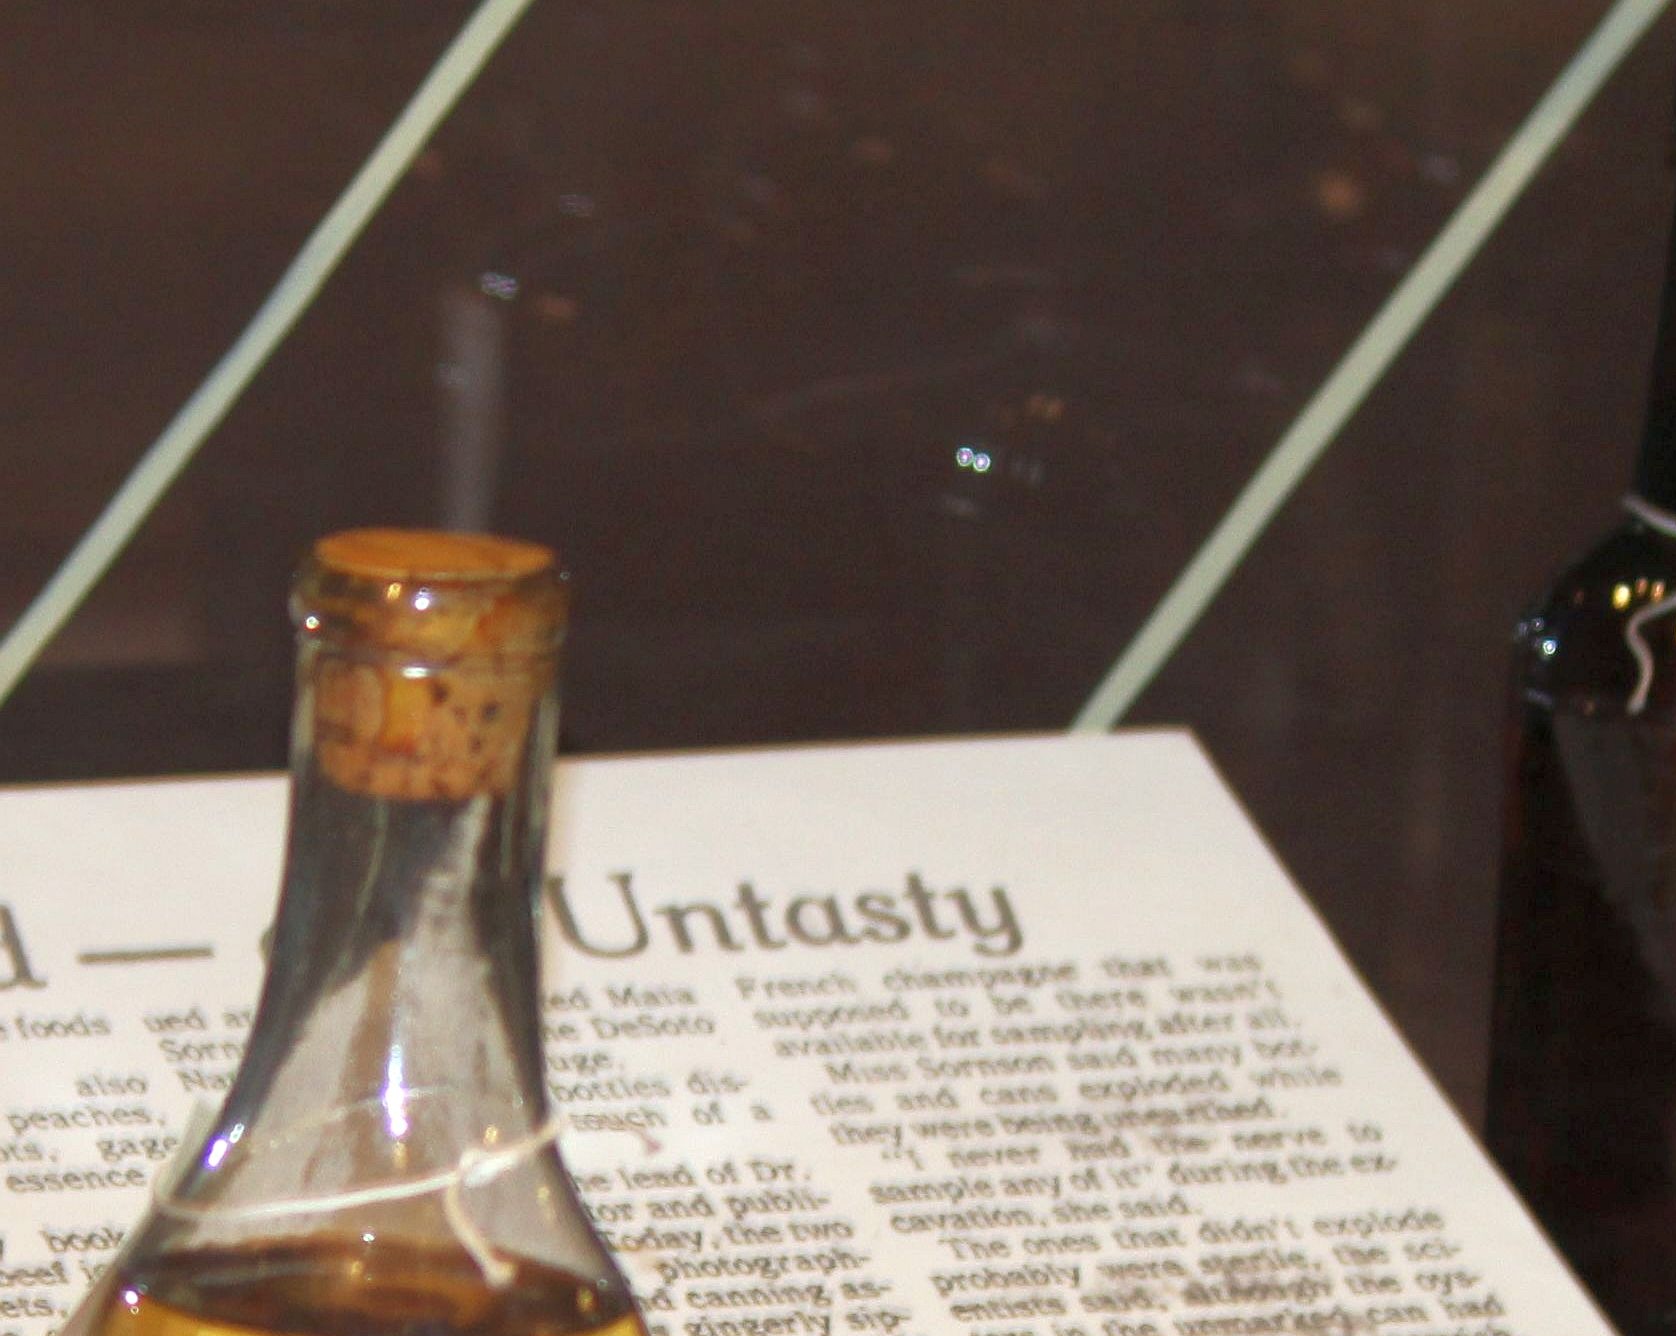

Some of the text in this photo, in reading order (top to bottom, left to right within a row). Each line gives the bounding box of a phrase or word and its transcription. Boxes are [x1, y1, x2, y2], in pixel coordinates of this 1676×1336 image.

[546, 869, 1024, 958] Untasty
[591, 1014, 716, 1040] DeSoto
[751, 1103, 774, 1122] a
[6, 1168, 148, 1193] essence
[616, 1163, 697, 1191] lead
[705, 1160, 739, 1184] of
[646, 1192, 715, 1219] and
[722, 1220, 854, 1244] the two
[928, 1262, 1082, 1298] probably
[685, 1284, 834, 1310] canning
